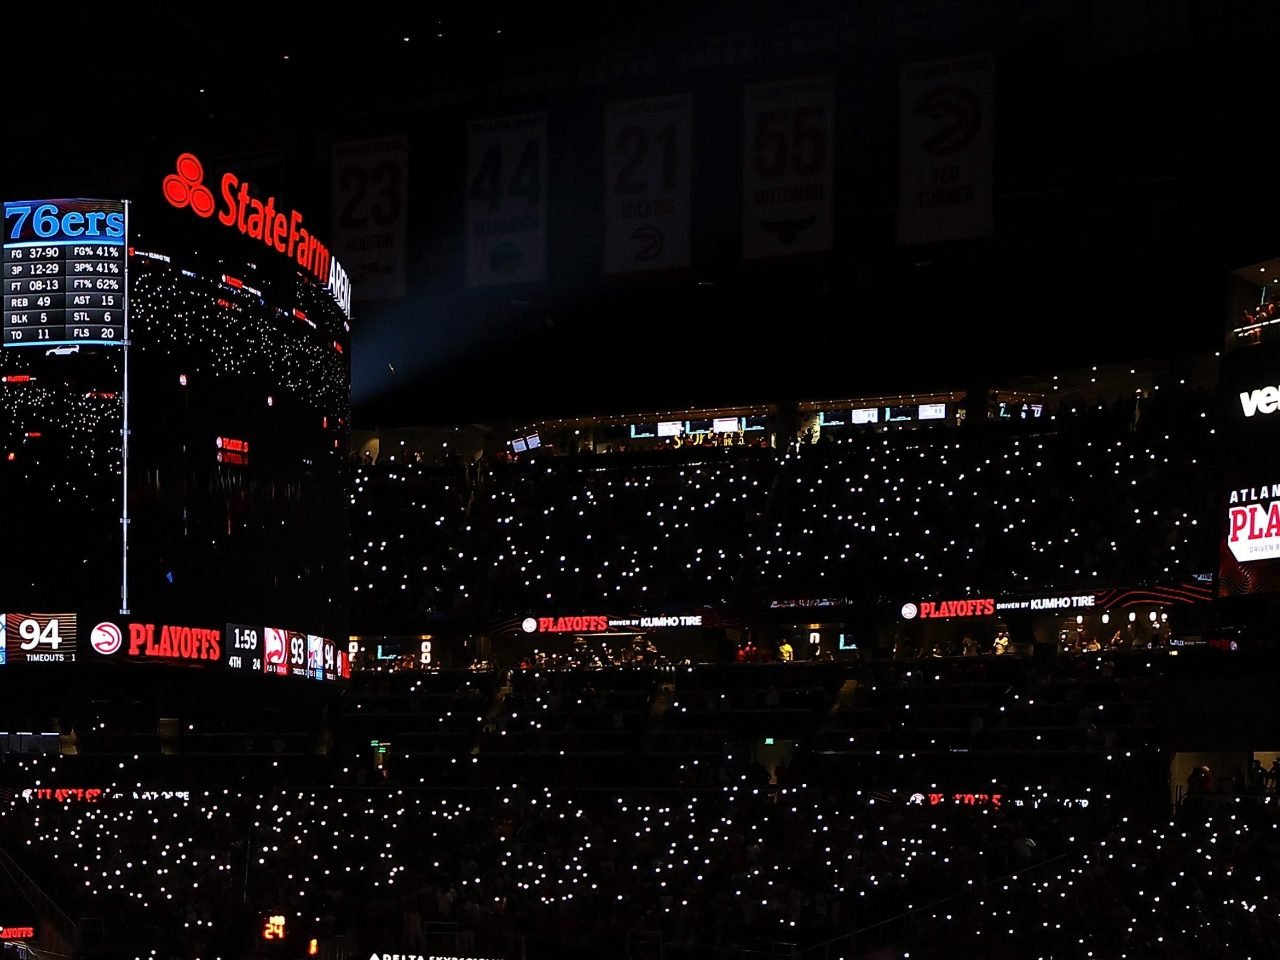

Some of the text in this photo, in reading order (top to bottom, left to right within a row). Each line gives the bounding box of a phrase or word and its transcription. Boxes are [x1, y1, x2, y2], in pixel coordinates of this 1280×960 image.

[339, 161, 402, 229] 23
[5, 204, 125, 239] 76ers
[12, 248, 59, 259] FG 37-90
[74, 247, 119, 257] FG% 41%
[12, 264, 59, 275] 3P 12-29
[74, 263, 119, 273] 3P% 41%
[12, 280, 59, 291] FT 08-13
[74, 280, 119, 289] FT% 62%
[11, 297, 51, 307] REB 49
[73, 296, 114, 305] AST 15
[11, 313, 47, 323] BLK 5
[73, 312, 111, 321] STL 6
[11, 329, 49, 340] TO 11
[73, 329, 114, 338] FLS 20
[1240, 386, 1280, 417] ve
[1250, 544, 1274, 553] DRIVEN
[919, 599, 995, 618] PLAYOFFS
[1030, 597, 1070, 609] KUMHO
[1071, 595, 1095, 607] TIRE
[538, 616, 608, 632] PLAYOFFS
[640, 617, 679, 627] KUMHO
[679, 616, 702, 626] TIRE
[19, 619, 63, 650] 94
[233, 627, 258, 650] 1:59
[128, 623, 221, 661] PLAYOFFS
[290, 637, 304, 665] 93
[26, 653, 76, 662] TIMEOUTS 1
[228, 654, 261, 671] 4TH 24
[324, 644, 334, 670] 94
[264, 923, 284, 940] 24
